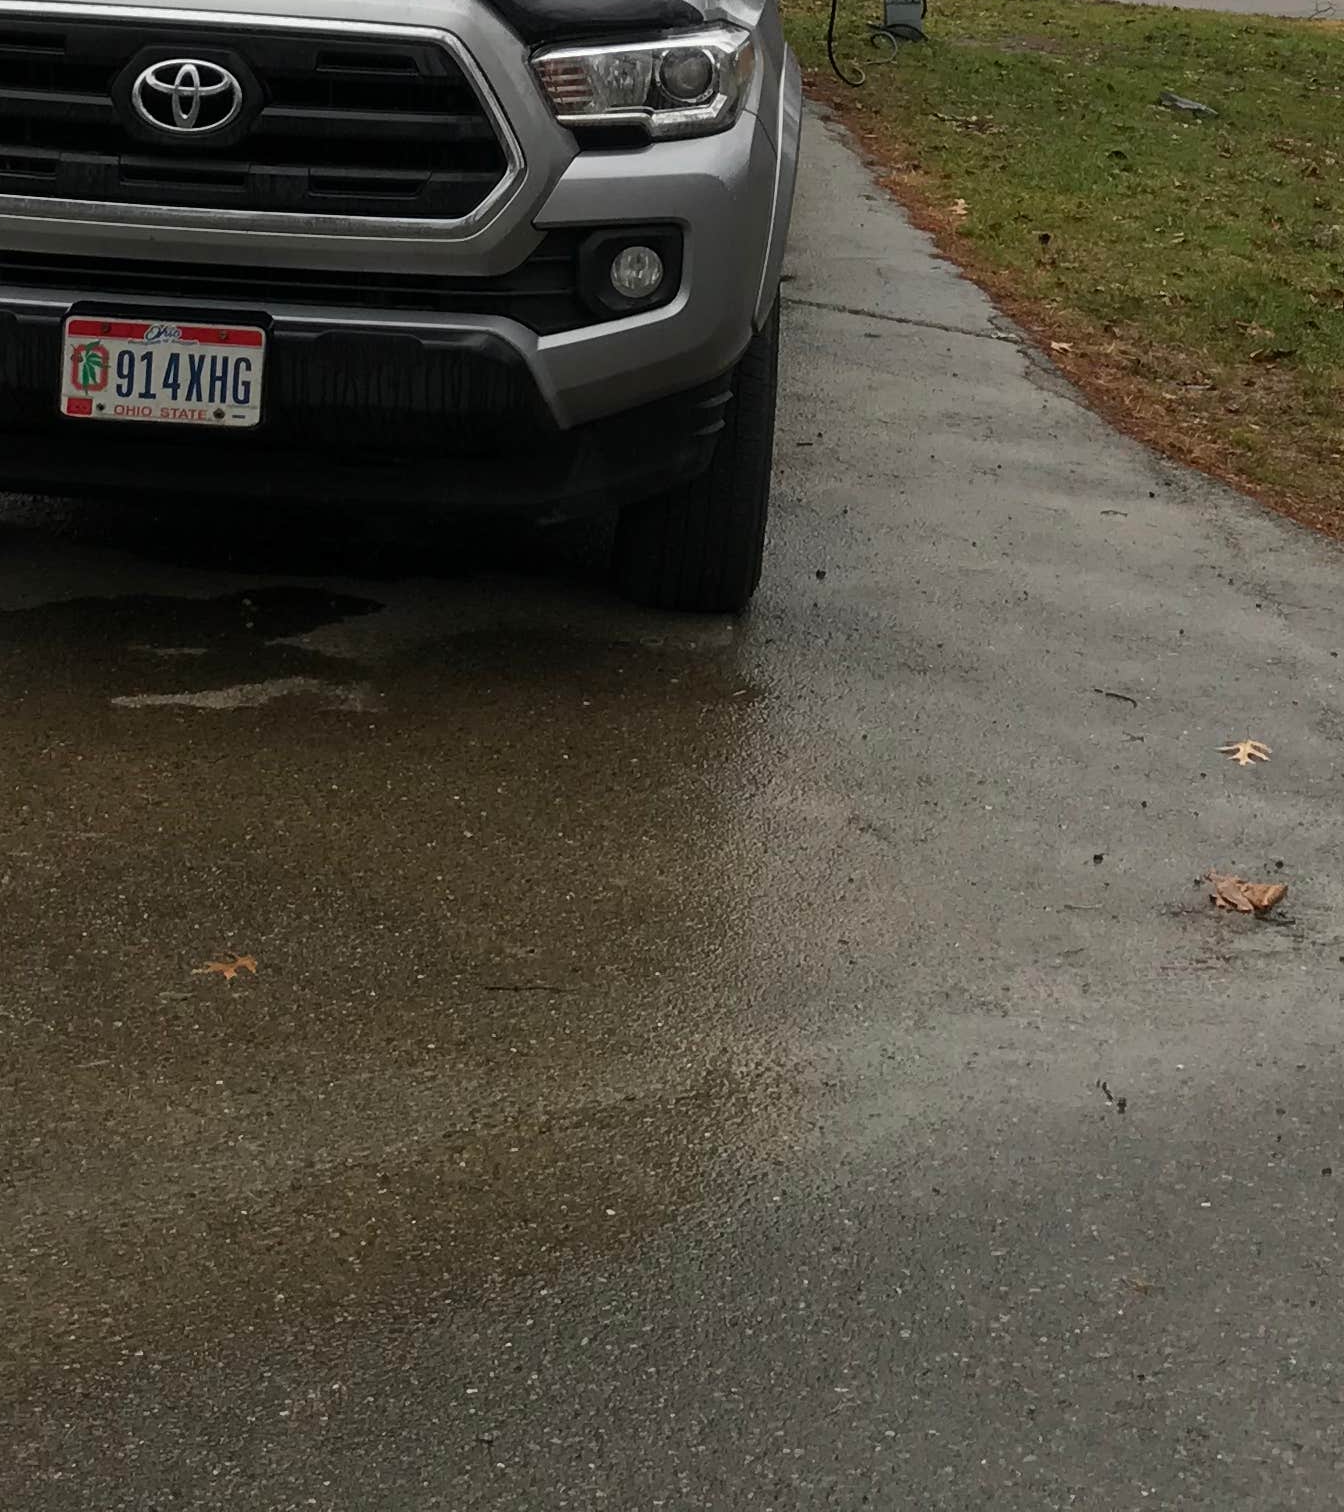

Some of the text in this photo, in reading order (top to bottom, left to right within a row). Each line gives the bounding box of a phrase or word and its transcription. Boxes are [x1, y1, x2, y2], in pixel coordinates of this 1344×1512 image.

[145, 325, 181, 341] Ohio
[116, 349, 252, 405] 914XHG
[113, 404, 207, 420] OHIO STATE
